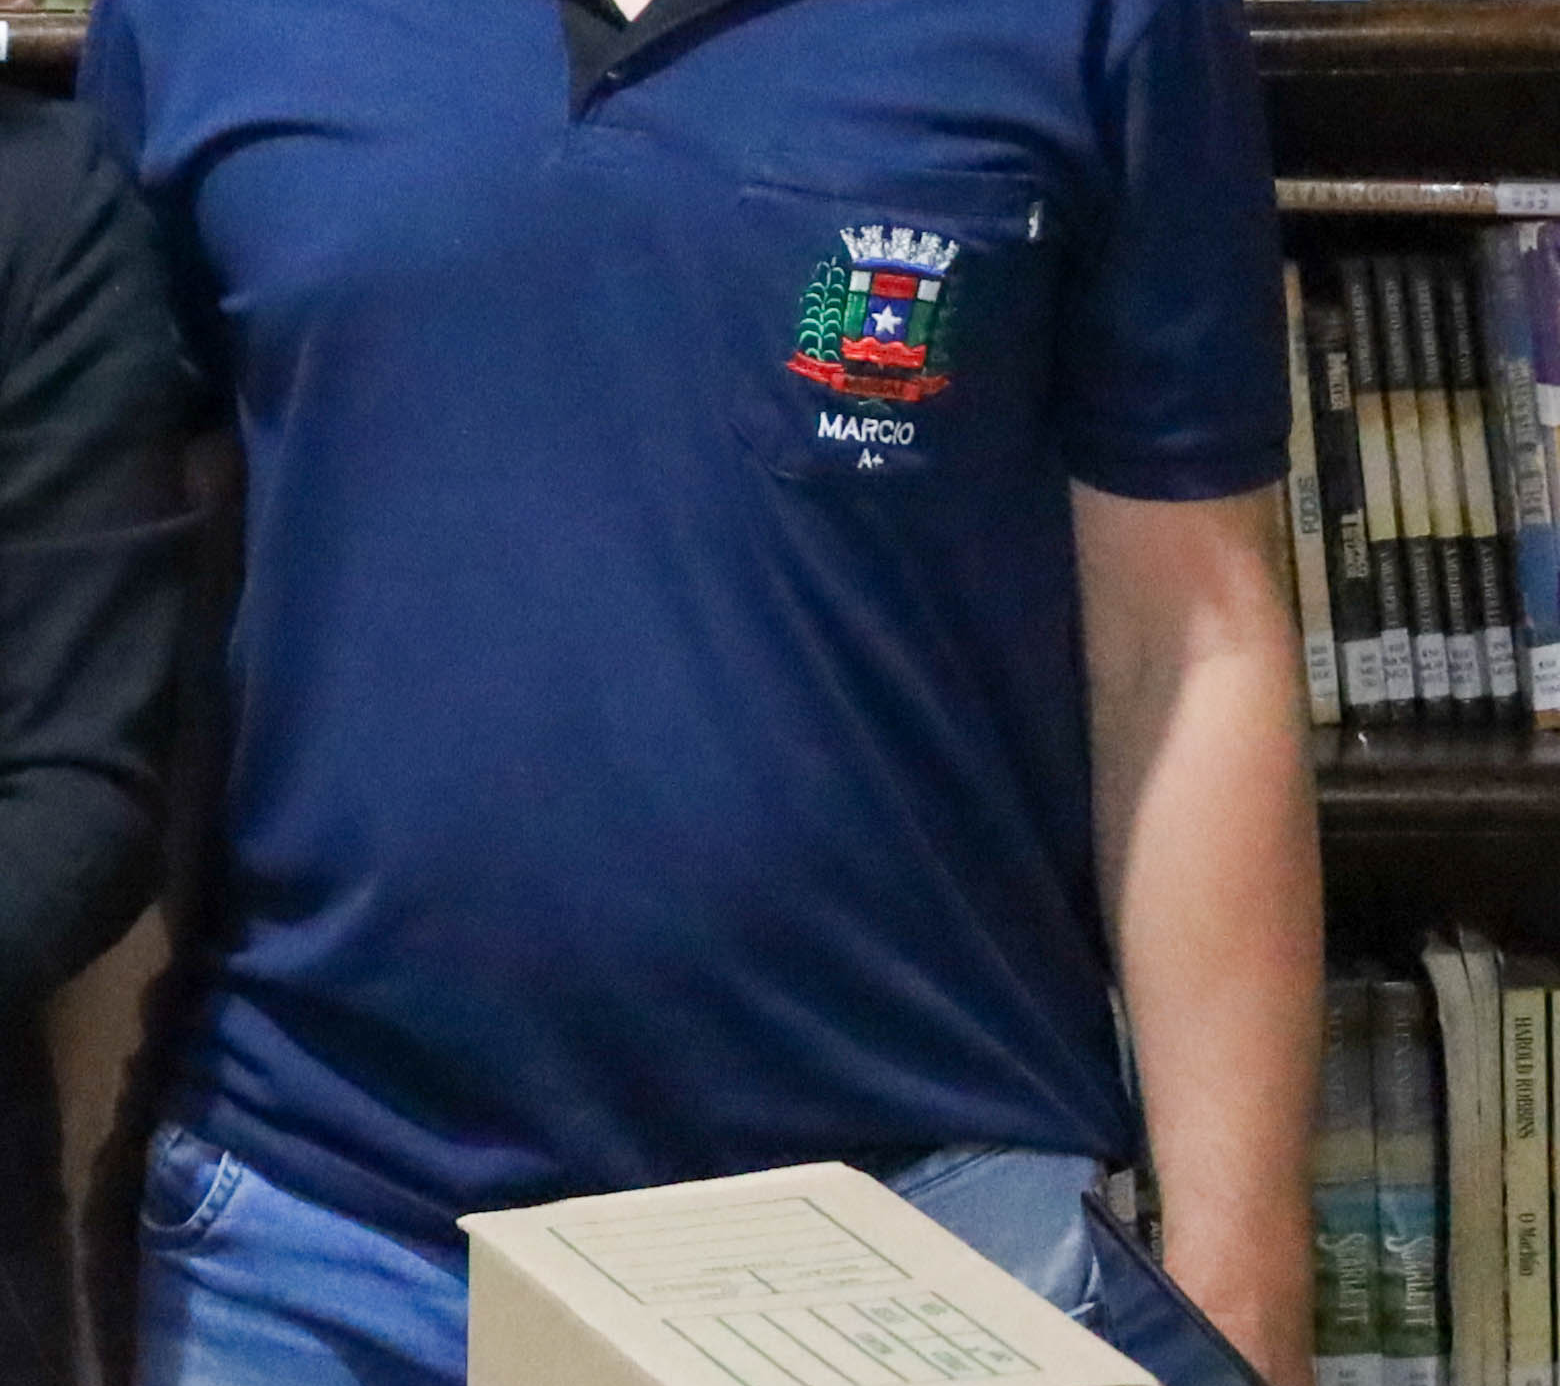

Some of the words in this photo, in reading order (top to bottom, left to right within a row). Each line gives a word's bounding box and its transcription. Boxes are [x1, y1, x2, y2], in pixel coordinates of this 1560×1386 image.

[818, 412, 915, 445] MARCIO
[857, 449, 884, 469] A+
[1514, 1016, 1534, 1074] HAROLD
[1515, 1078, 1535, 1139] ROBBINS
